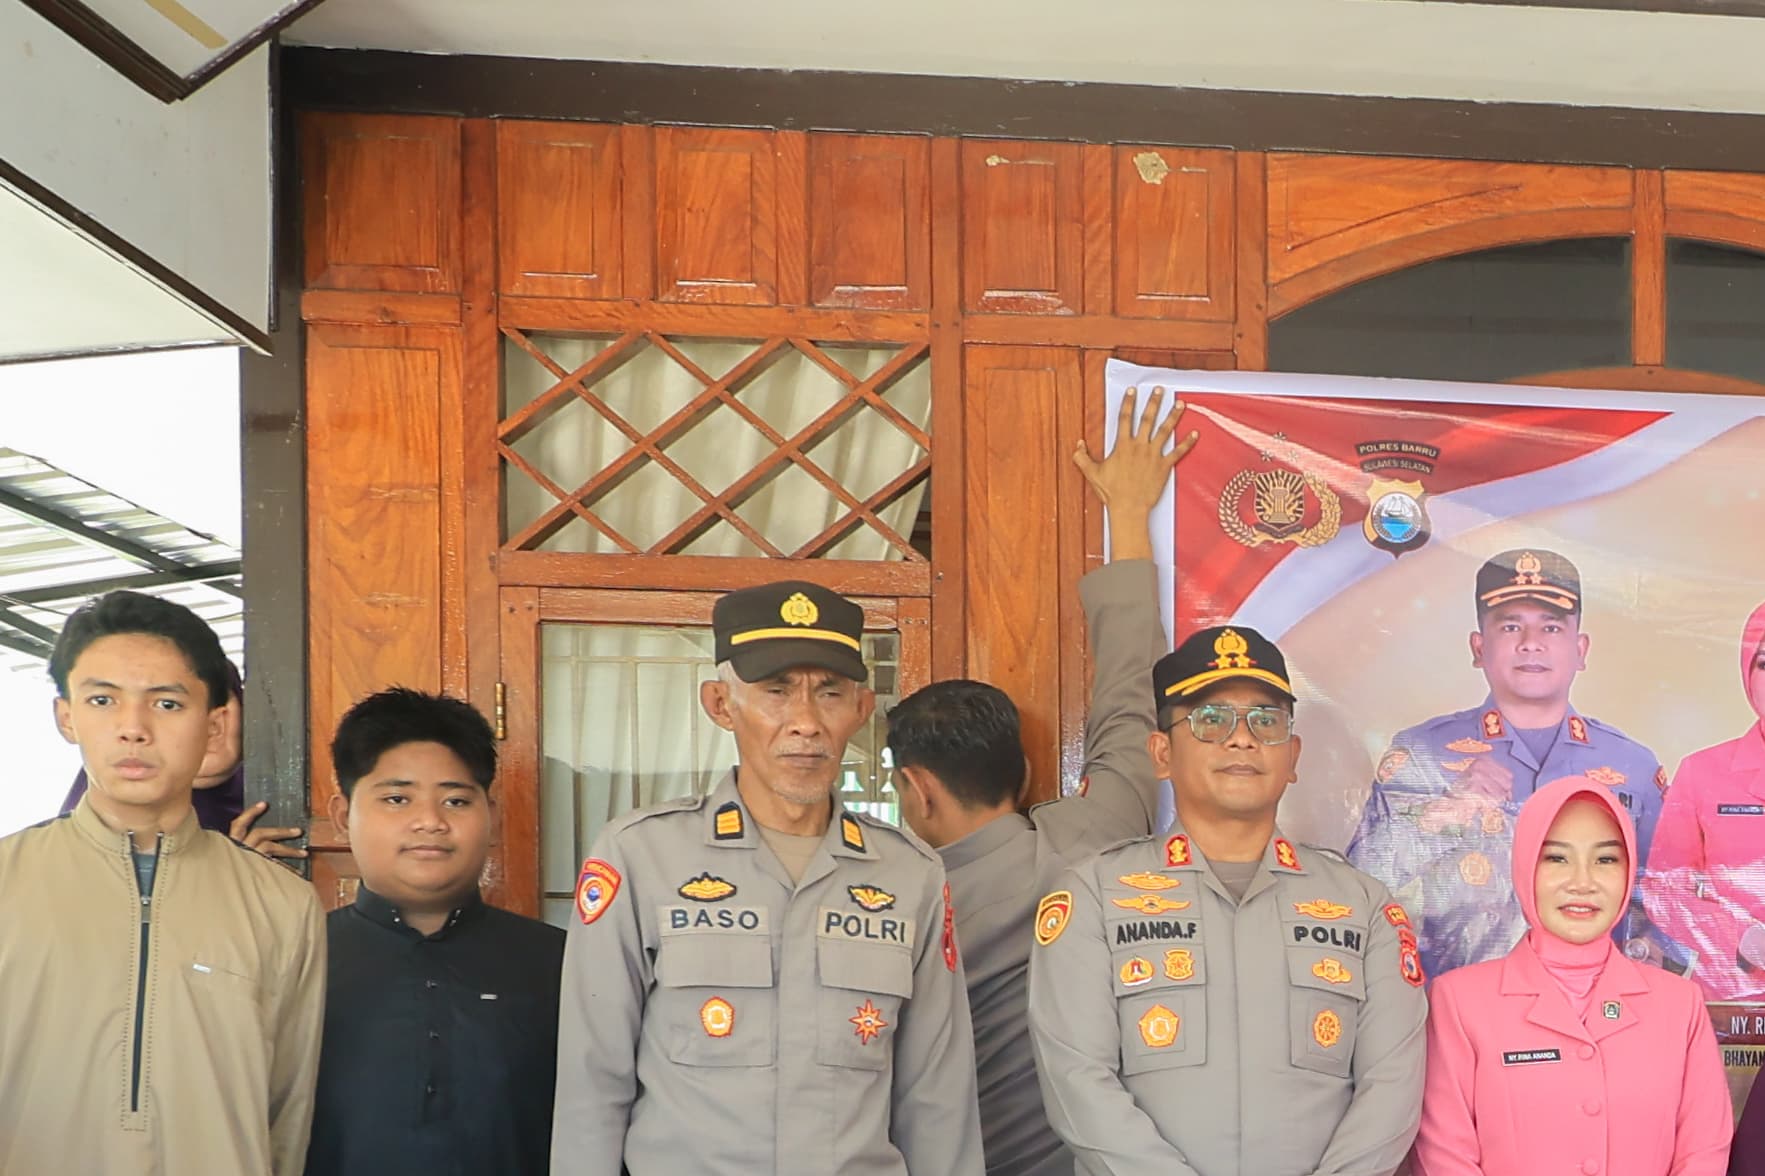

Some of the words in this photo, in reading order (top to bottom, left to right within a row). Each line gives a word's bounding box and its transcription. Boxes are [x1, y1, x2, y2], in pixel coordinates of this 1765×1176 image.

[1359, 443, 1399, 453] POLRES
[1401, 443, 1437, 457] BARRU
[670, 908, 759, 930] BASO
[825, 912, 906, 943] POLRI
[1116, 921, 1198, 945] ANANDA.F
[1294, 925, 1361, 952] POLRI
[1731, 1016, 1751, 1035] NY.
